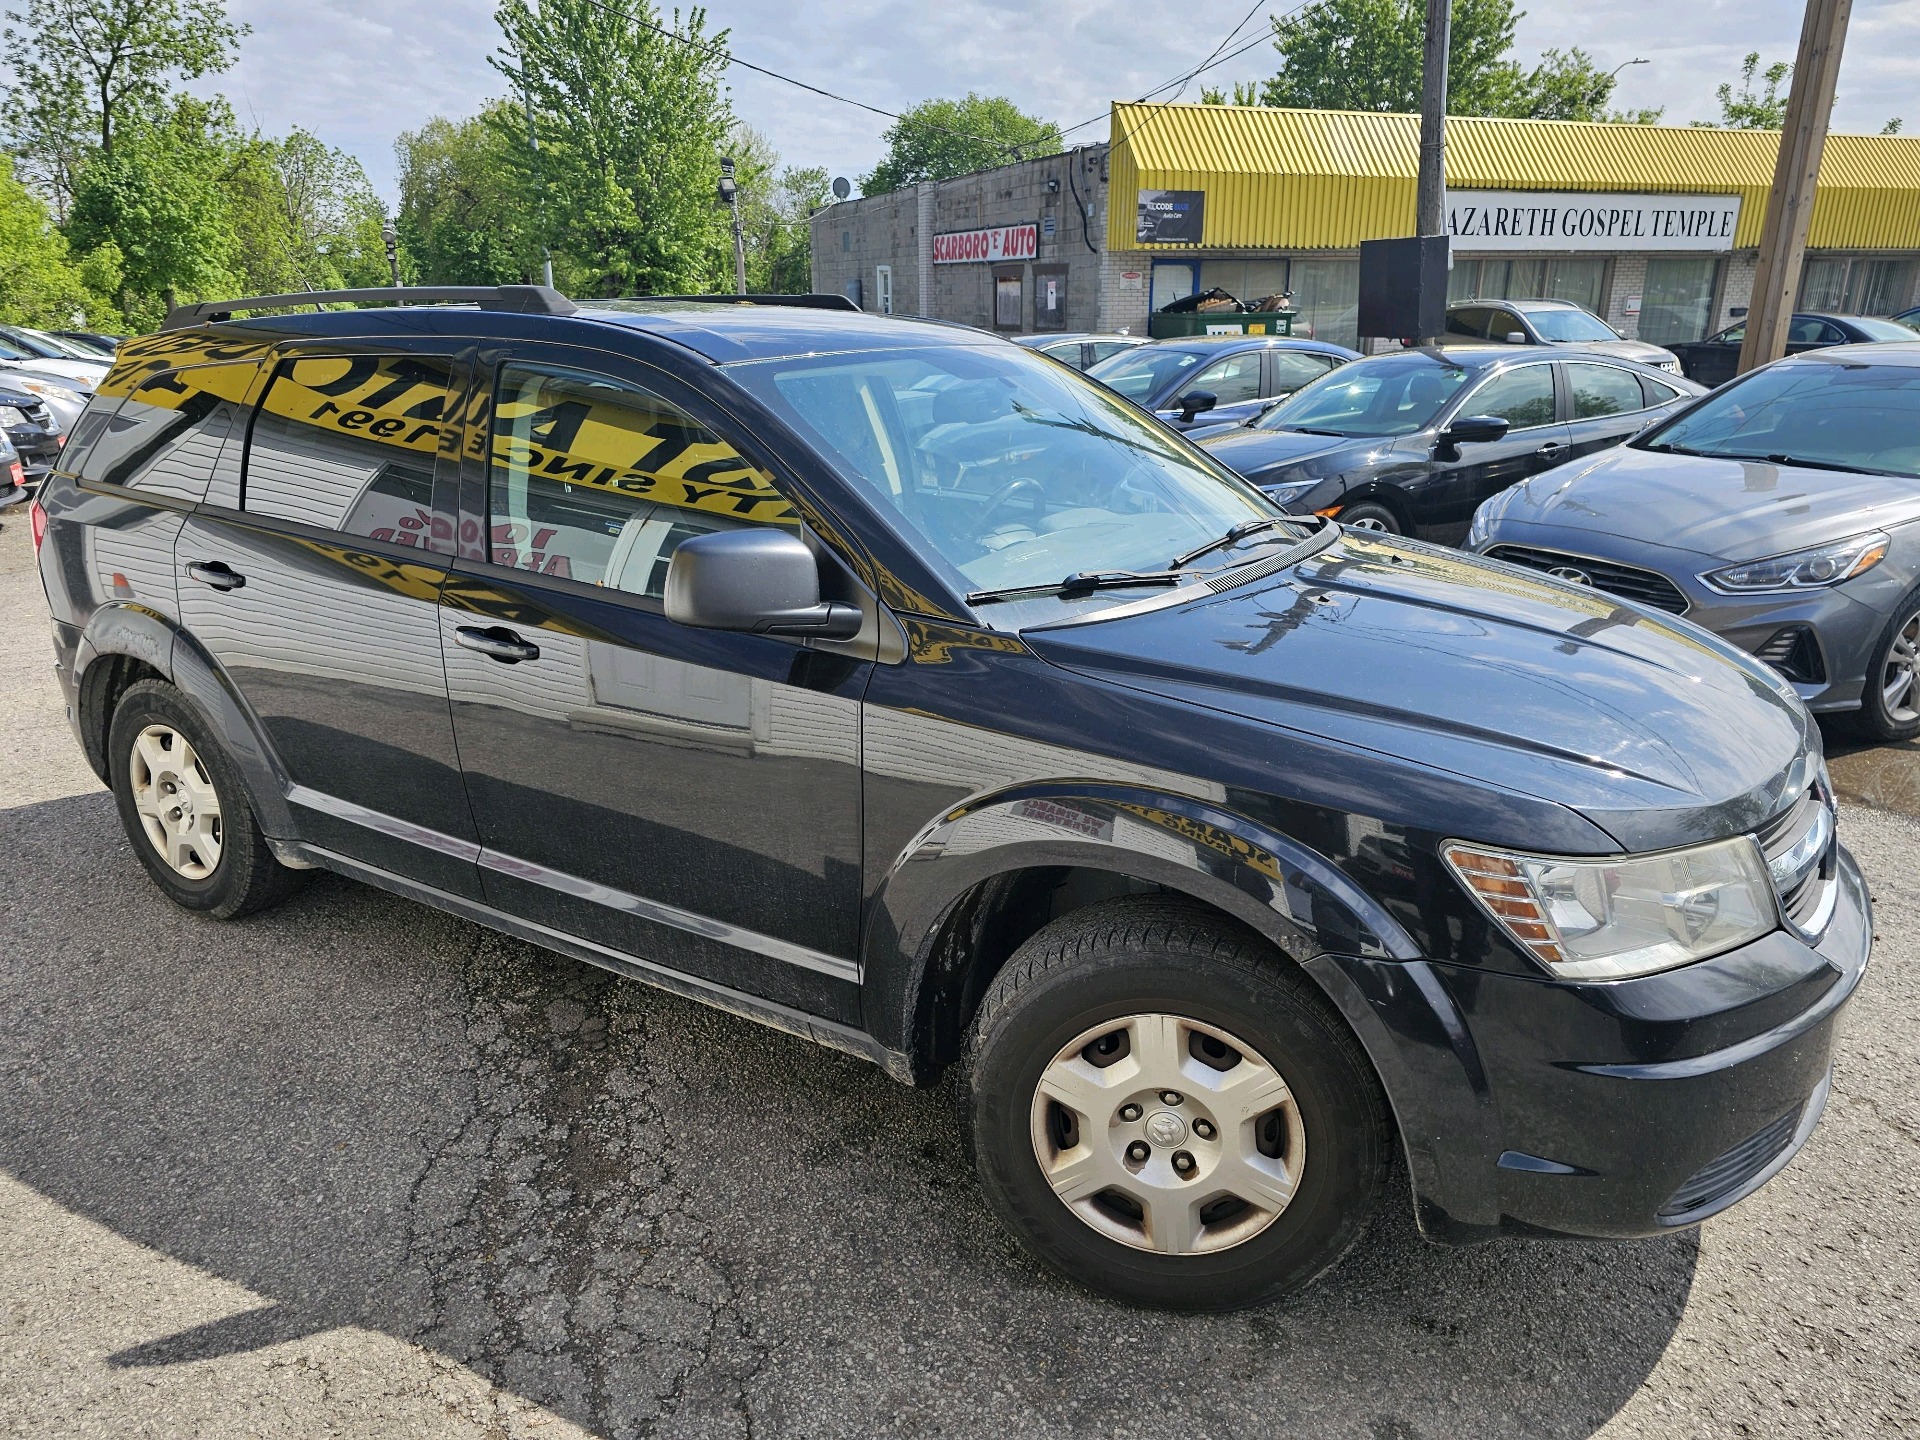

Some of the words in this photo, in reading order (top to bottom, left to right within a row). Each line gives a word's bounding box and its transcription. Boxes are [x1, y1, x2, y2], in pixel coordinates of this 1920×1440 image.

[1447, 206, 1557, 237] AZARETH
[1561, 208, 1646, 237] GOSPEL
[1650, 209, 1734, 238] TEMPLE
[933, 231, 989, 261] SCARBORO
[1002, 226, 1036, 257] AUTO
